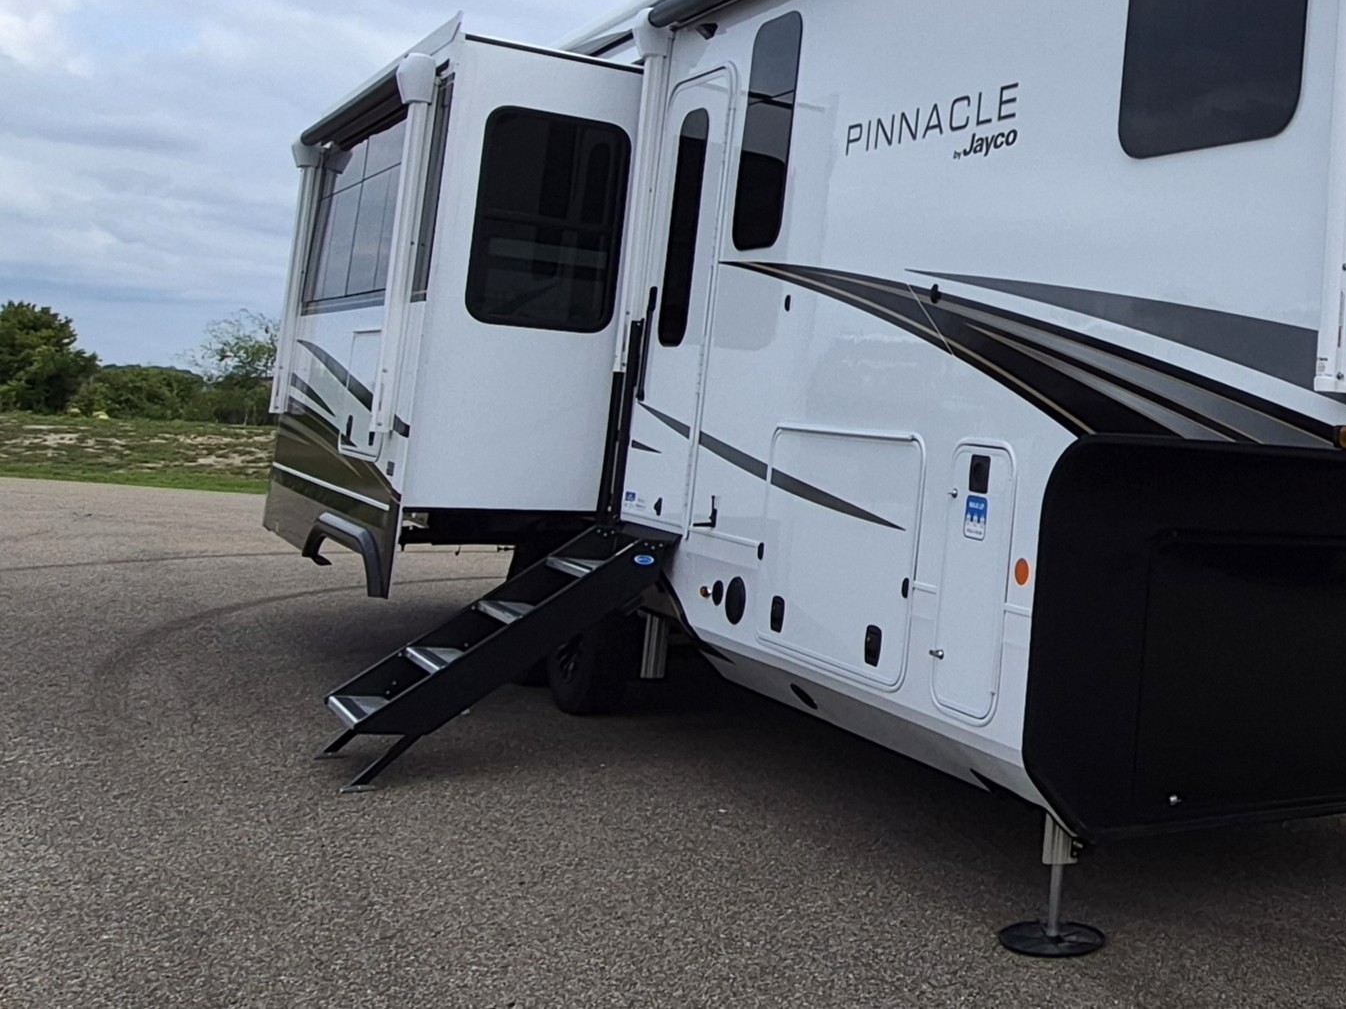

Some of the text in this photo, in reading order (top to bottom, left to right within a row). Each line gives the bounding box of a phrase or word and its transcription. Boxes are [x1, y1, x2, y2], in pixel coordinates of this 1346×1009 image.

[846, 82, 1019, 156] PINNACLE
[953, 129, 1018, 160] by Jayco
